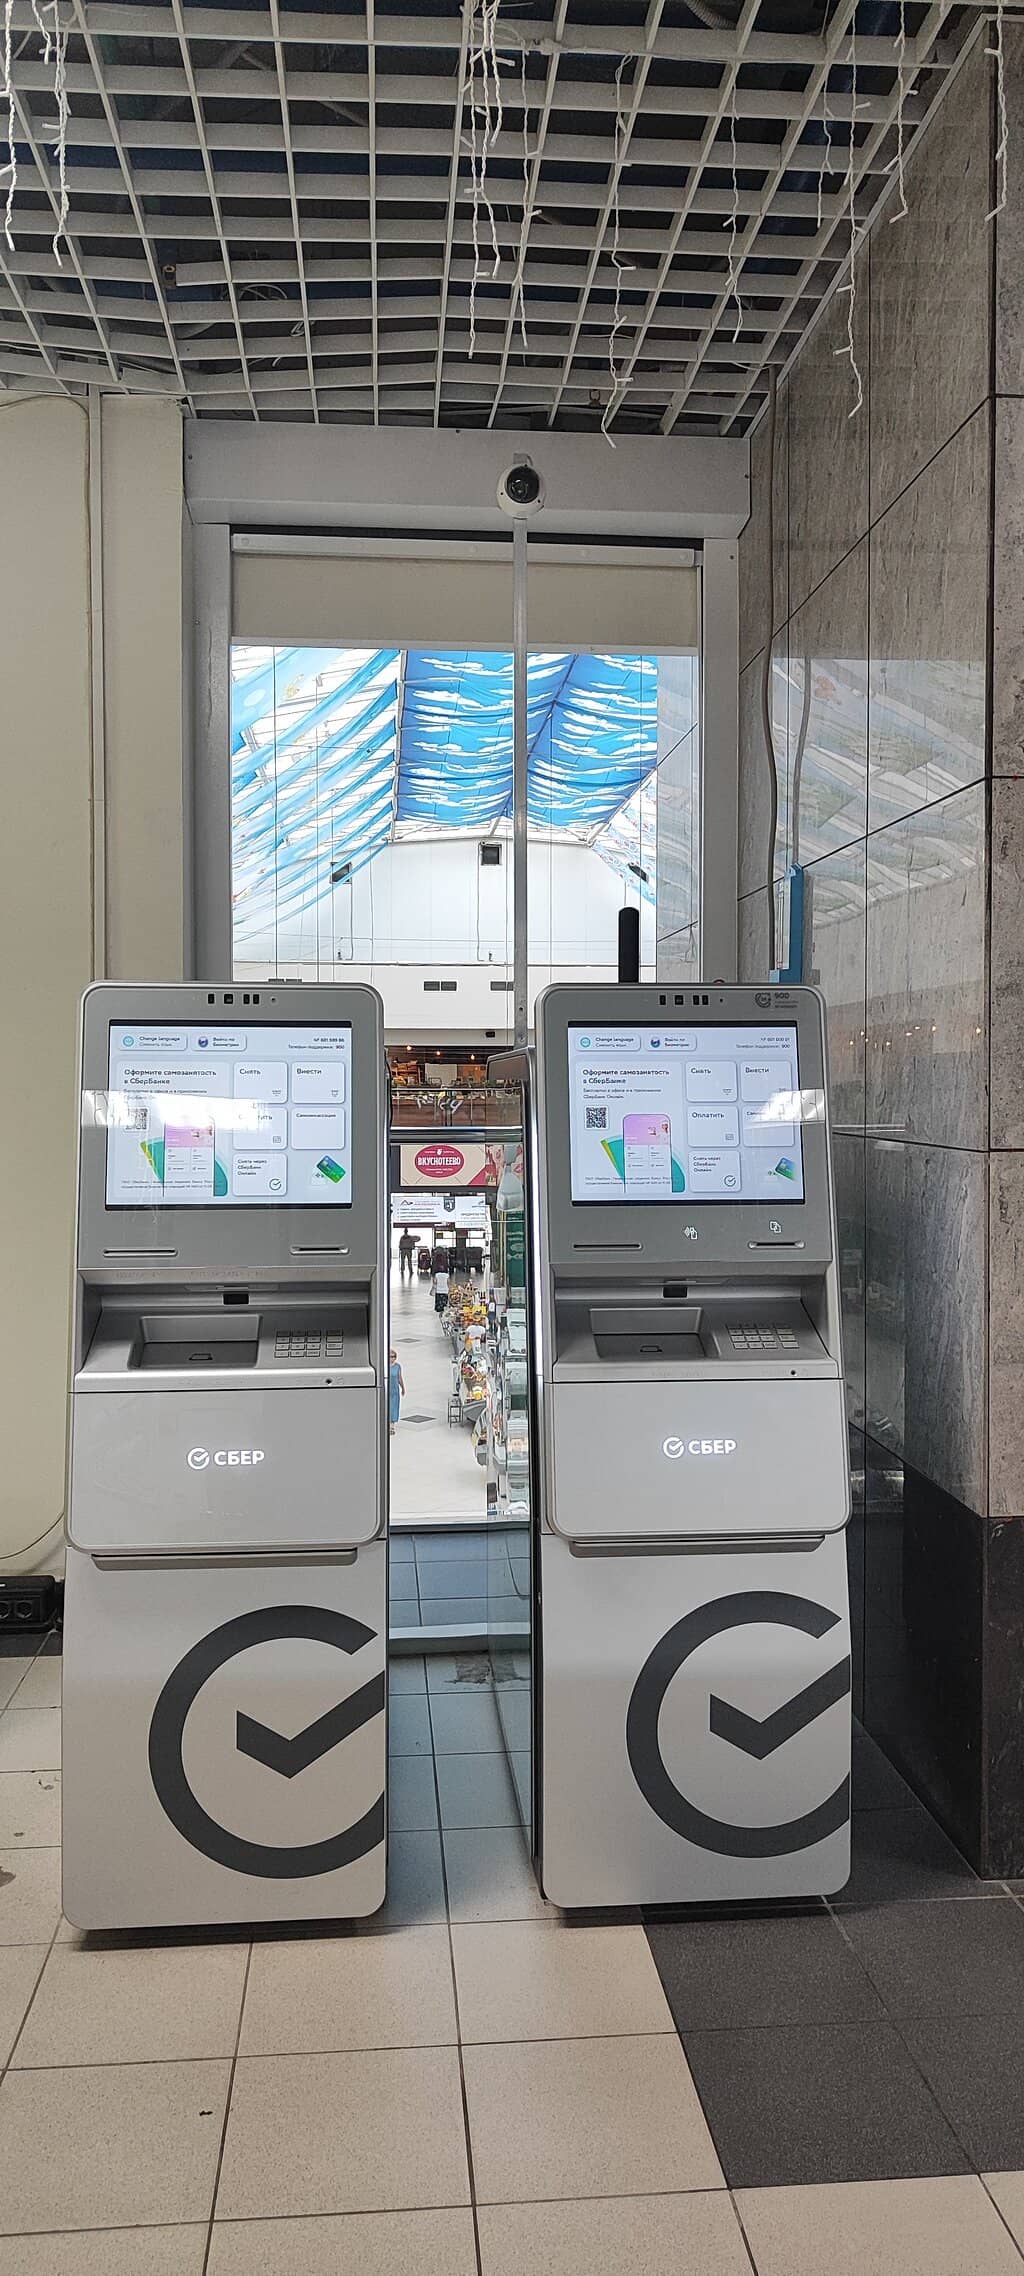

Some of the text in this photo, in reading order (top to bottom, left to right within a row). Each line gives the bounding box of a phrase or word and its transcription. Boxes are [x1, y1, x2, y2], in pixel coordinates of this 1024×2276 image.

[417, 1157, 461, 1166] ВКУСНОТЕЕВО
[688, 1439, 736, 1455] СБЕР
[214, 1450, 265, 1466] СБЕР
